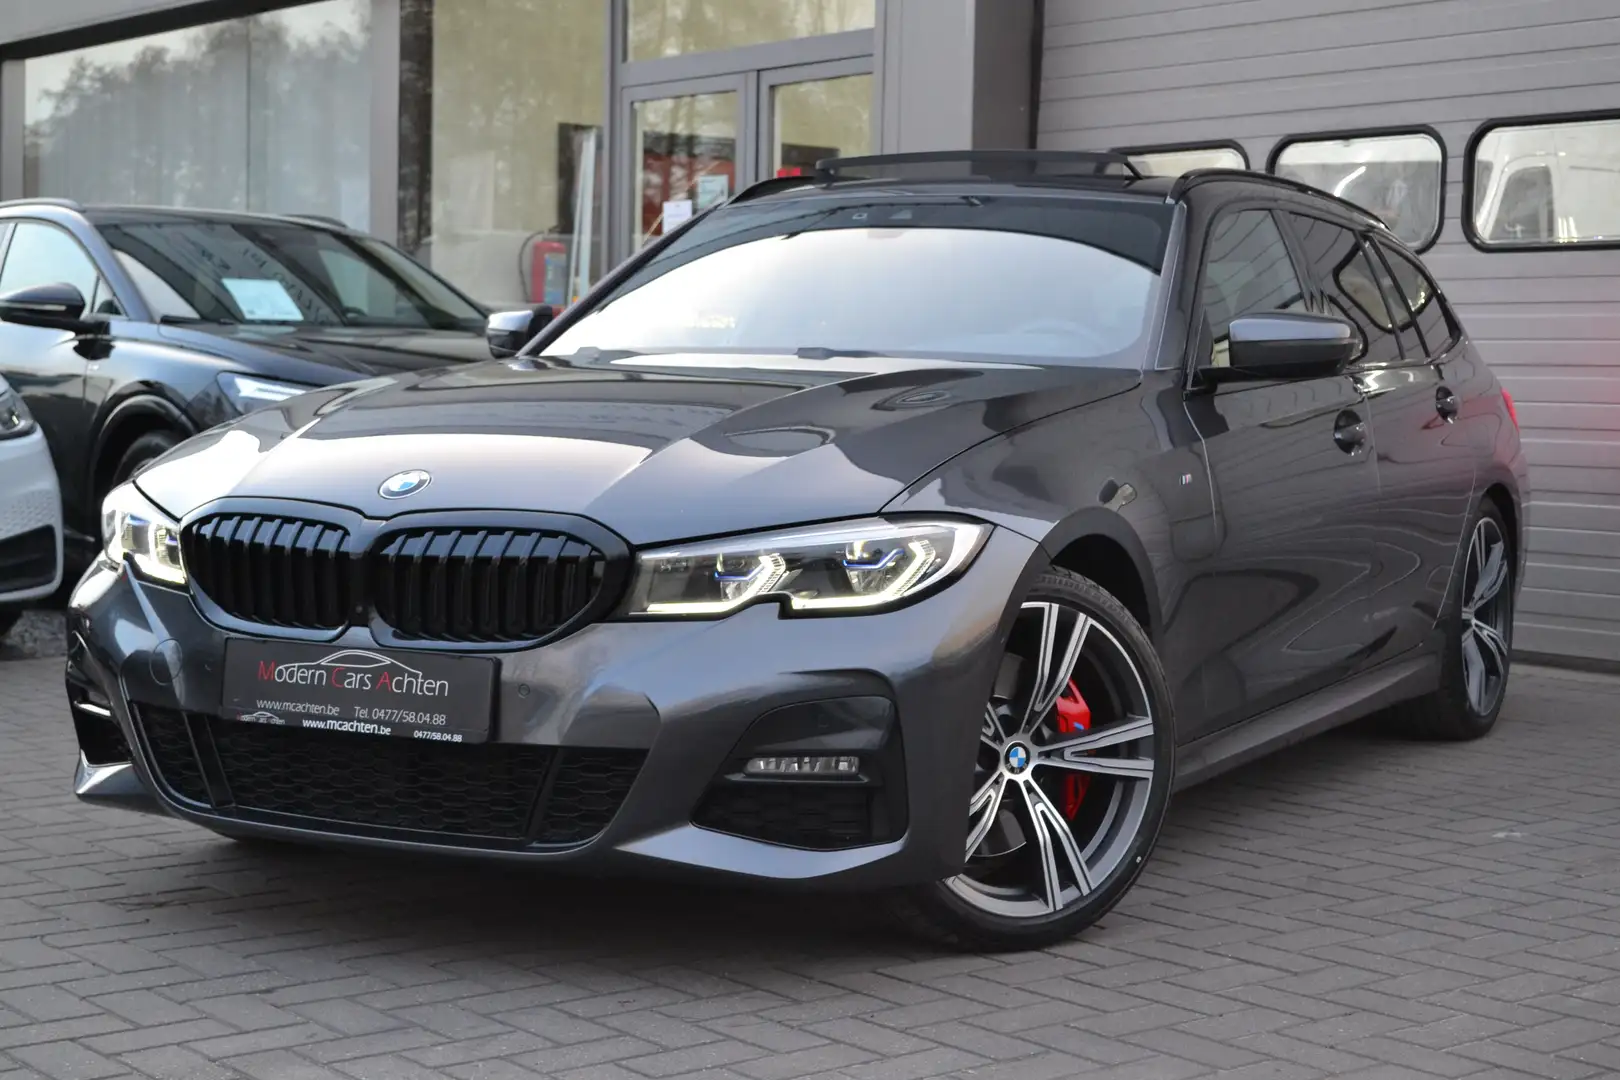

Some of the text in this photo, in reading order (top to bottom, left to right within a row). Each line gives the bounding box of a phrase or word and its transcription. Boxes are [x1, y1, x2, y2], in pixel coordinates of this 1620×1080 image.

[258, 660, 449, 697] Modern Cars Achten
[256, 699, 340, 716] www.mcachten.be
[371, 708, 447, 726] 0477/58.04.88
[302, 718, 392, 736] www.mcachten.be
[413, 730, 463, 743] 0477/58.04.88
